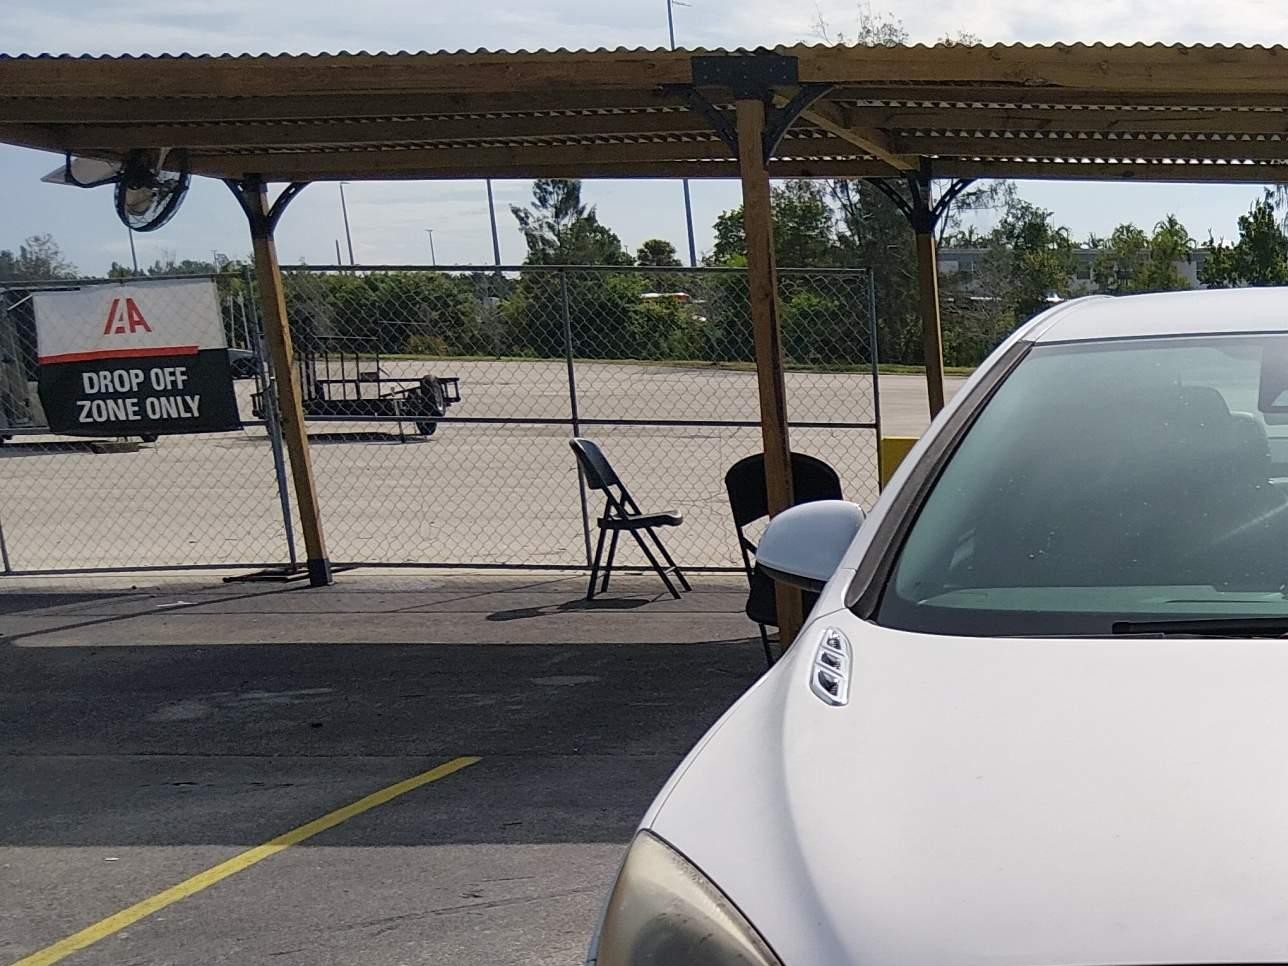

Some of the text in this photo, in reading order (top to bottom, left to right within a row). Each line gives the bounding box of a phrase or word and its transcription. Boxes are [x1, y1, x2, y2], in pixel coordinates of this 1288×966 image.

[82, 367, 188, 394] DROP OFF
[76, 395, 201, 423] ZONE ONLY
